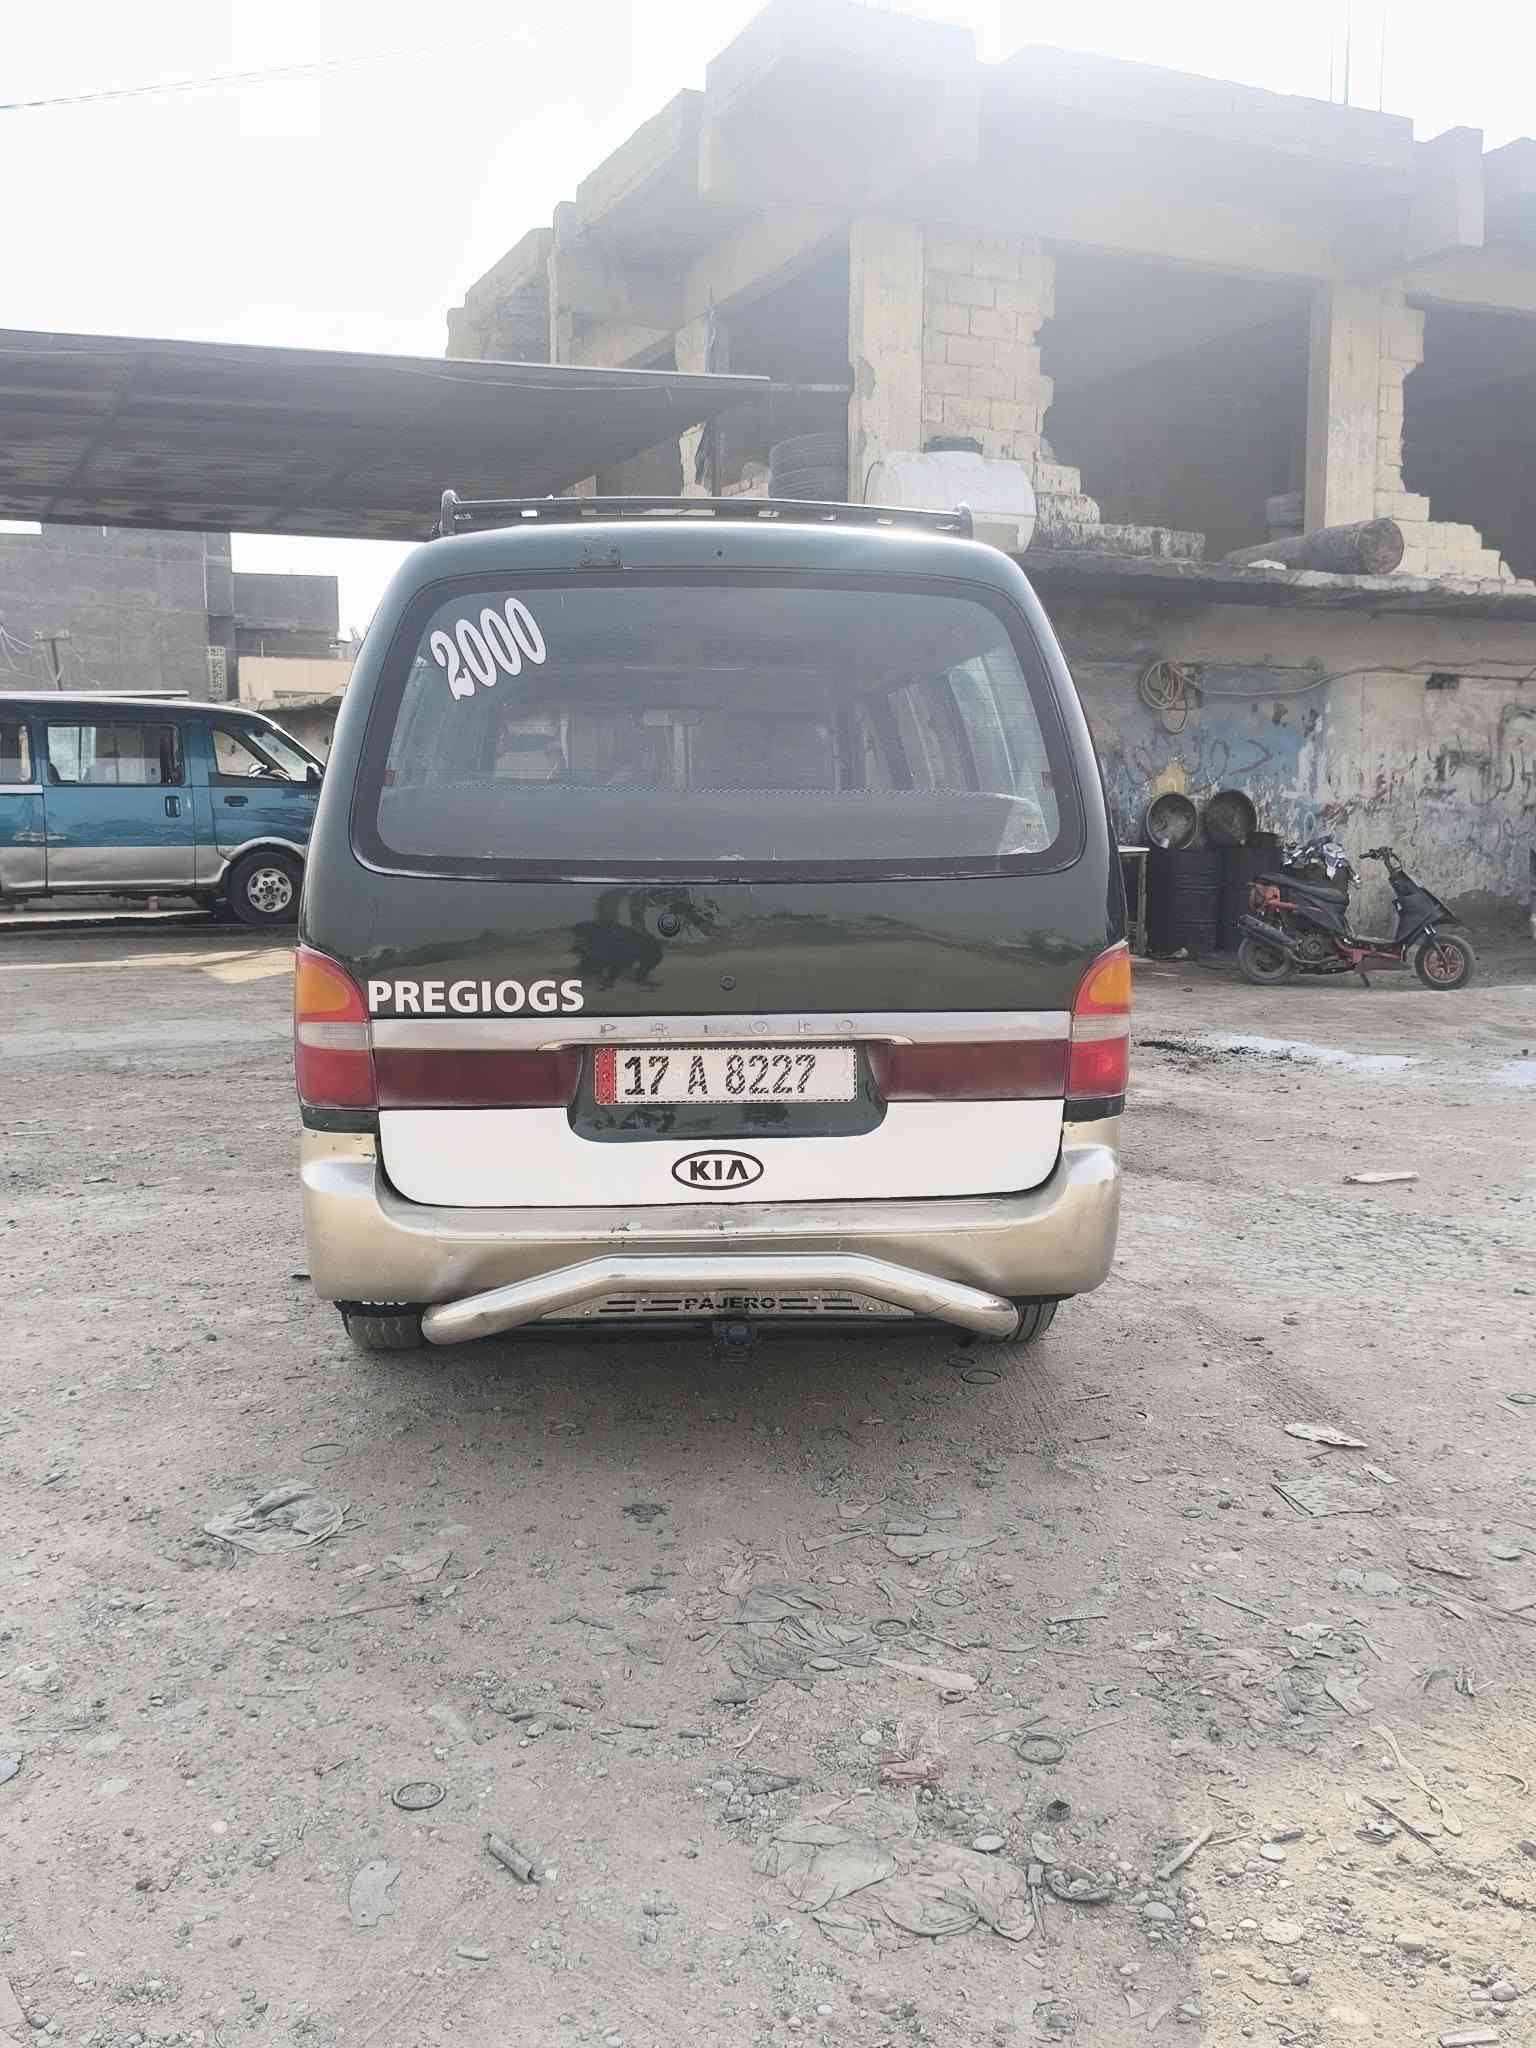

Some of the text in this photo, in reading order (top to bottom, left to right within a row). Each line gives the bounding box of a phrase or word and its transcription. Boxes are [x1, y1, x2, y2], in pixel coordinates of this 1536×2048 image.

[430, 597, 547, 701] 2000
[367, 979, 585, 1013] PREGIOGS
[624, 1055, 670, 1096] 17
[687, 1055, 709, 1095] A
[724, 1054, 816, 1095] 8227
[689, 1159, 749, 1181] KIA
[684, 1297, 776, 1310] PAJERO
